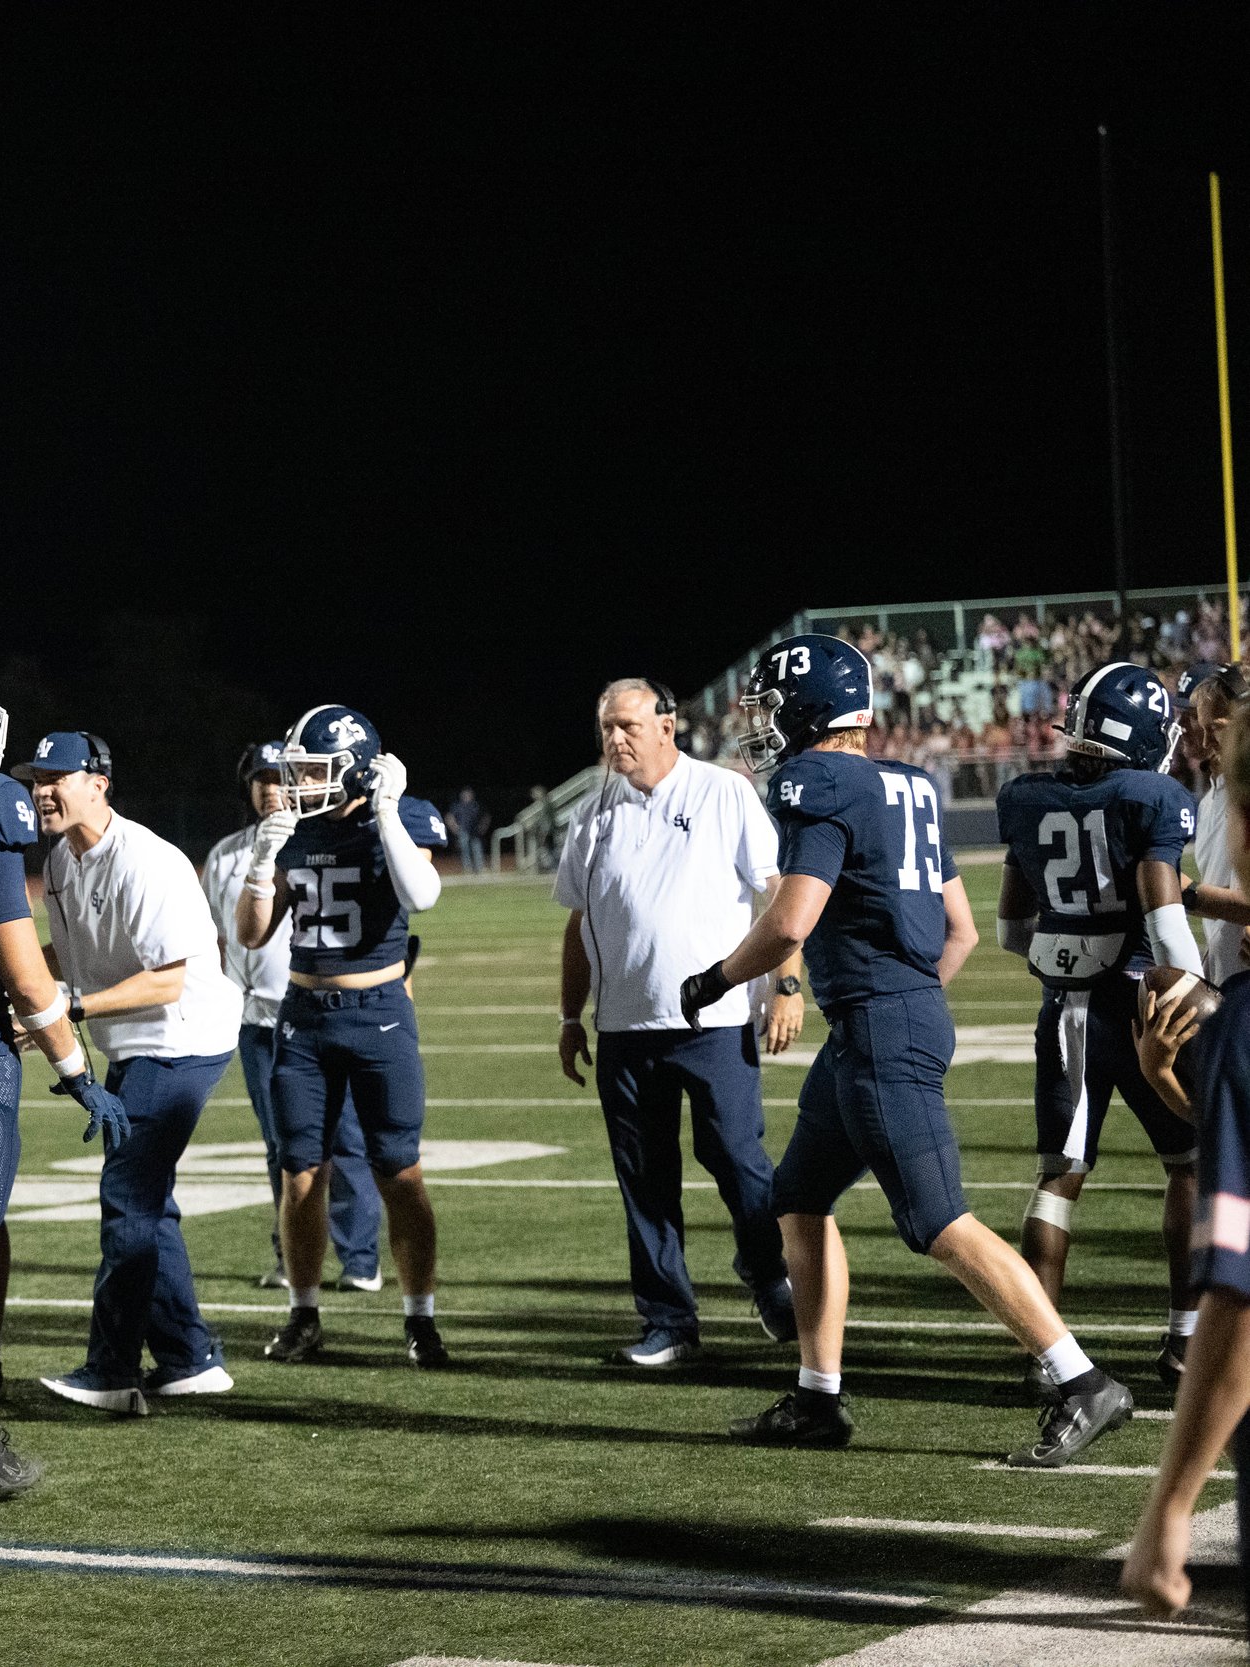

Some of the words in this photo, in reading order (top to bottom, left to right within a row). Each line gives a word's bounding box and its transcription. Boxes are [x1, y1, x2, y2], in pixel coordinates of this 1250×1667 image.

[772, 646, 811, 680] 73
[1147, 681, 1170, 718] 21
[328, 714, 368, 749] 25
[780, 780, 804, 806] SV
[674, 813, 692, 832] SV
[879, 772, 943, 893] 73
[1038, 809, 1127, 916] 21
[287, 867, 362, 949] 25
[1056, 949, 1079, 975] SV
